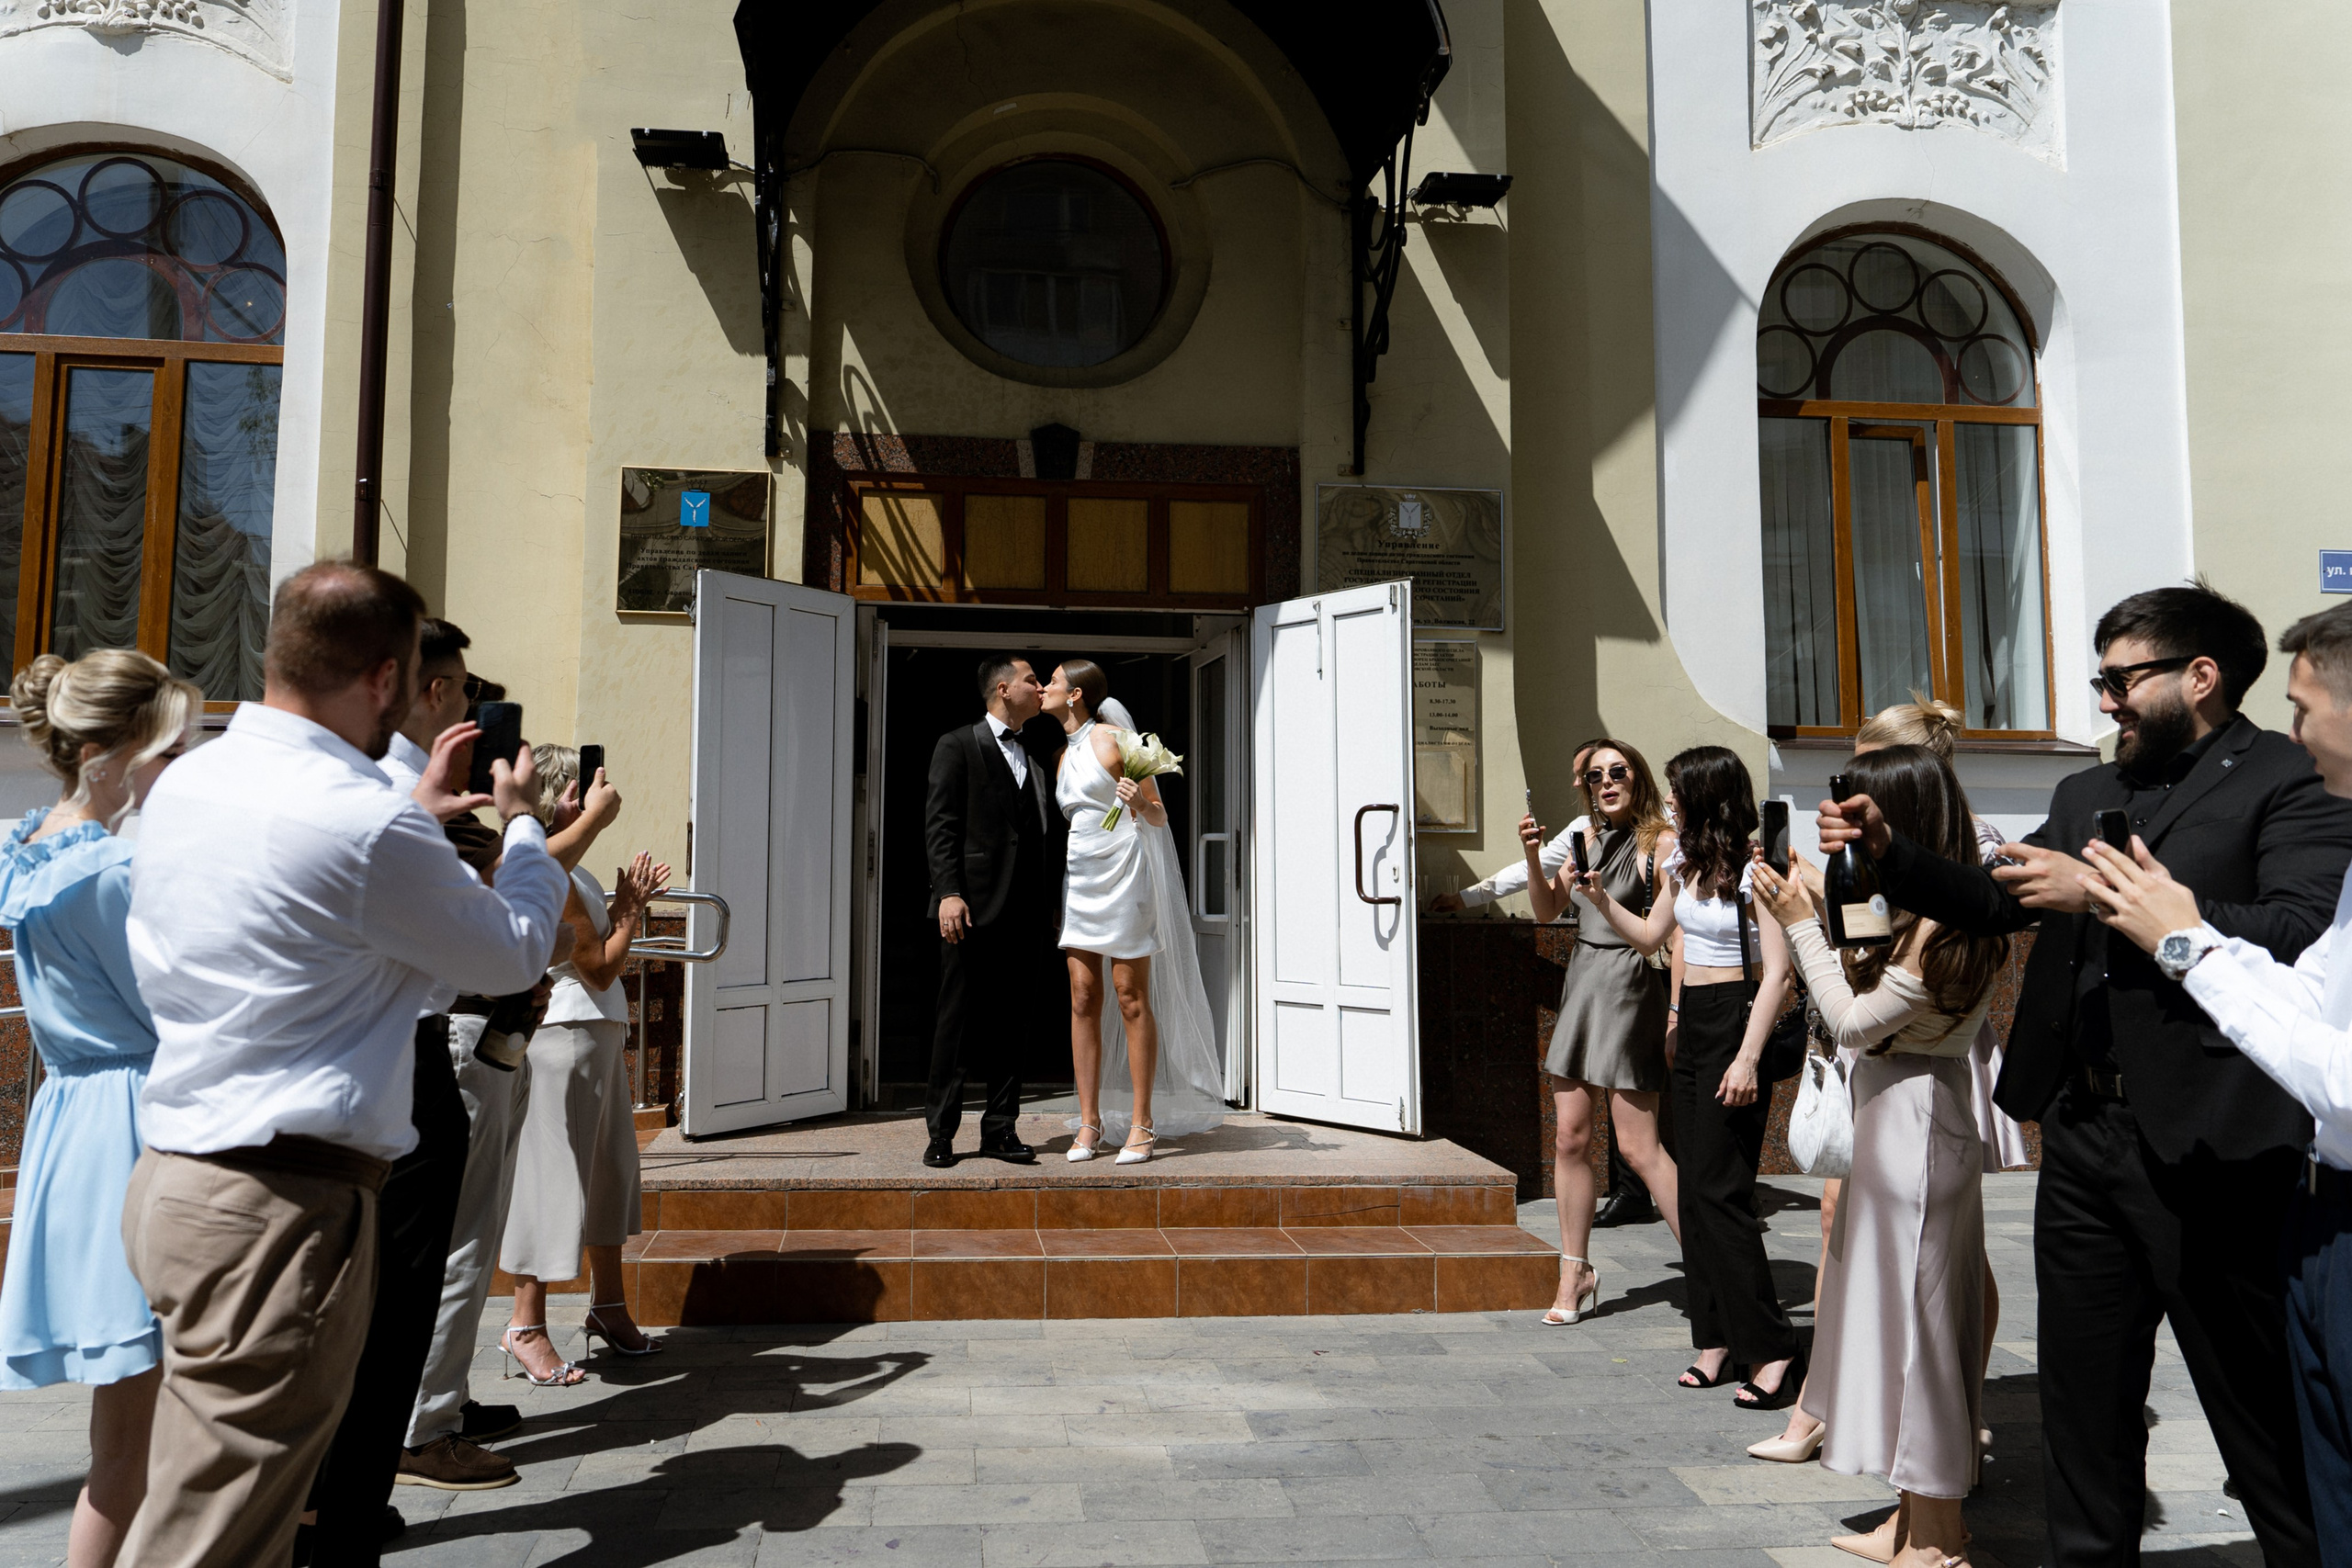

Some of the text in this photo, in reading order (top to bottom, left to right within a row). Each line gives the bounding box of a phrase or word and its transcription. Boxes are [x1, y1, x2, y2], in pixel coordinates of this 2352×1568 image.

[1377, 539, 1441, 550] Управление
[640, 547, 684, 555] Управление
[1348, 568, 1444, 578] СПЕЦИАЛИЗИРОВАННЫЙ
[2326, 566, 2346, 578] ул.
